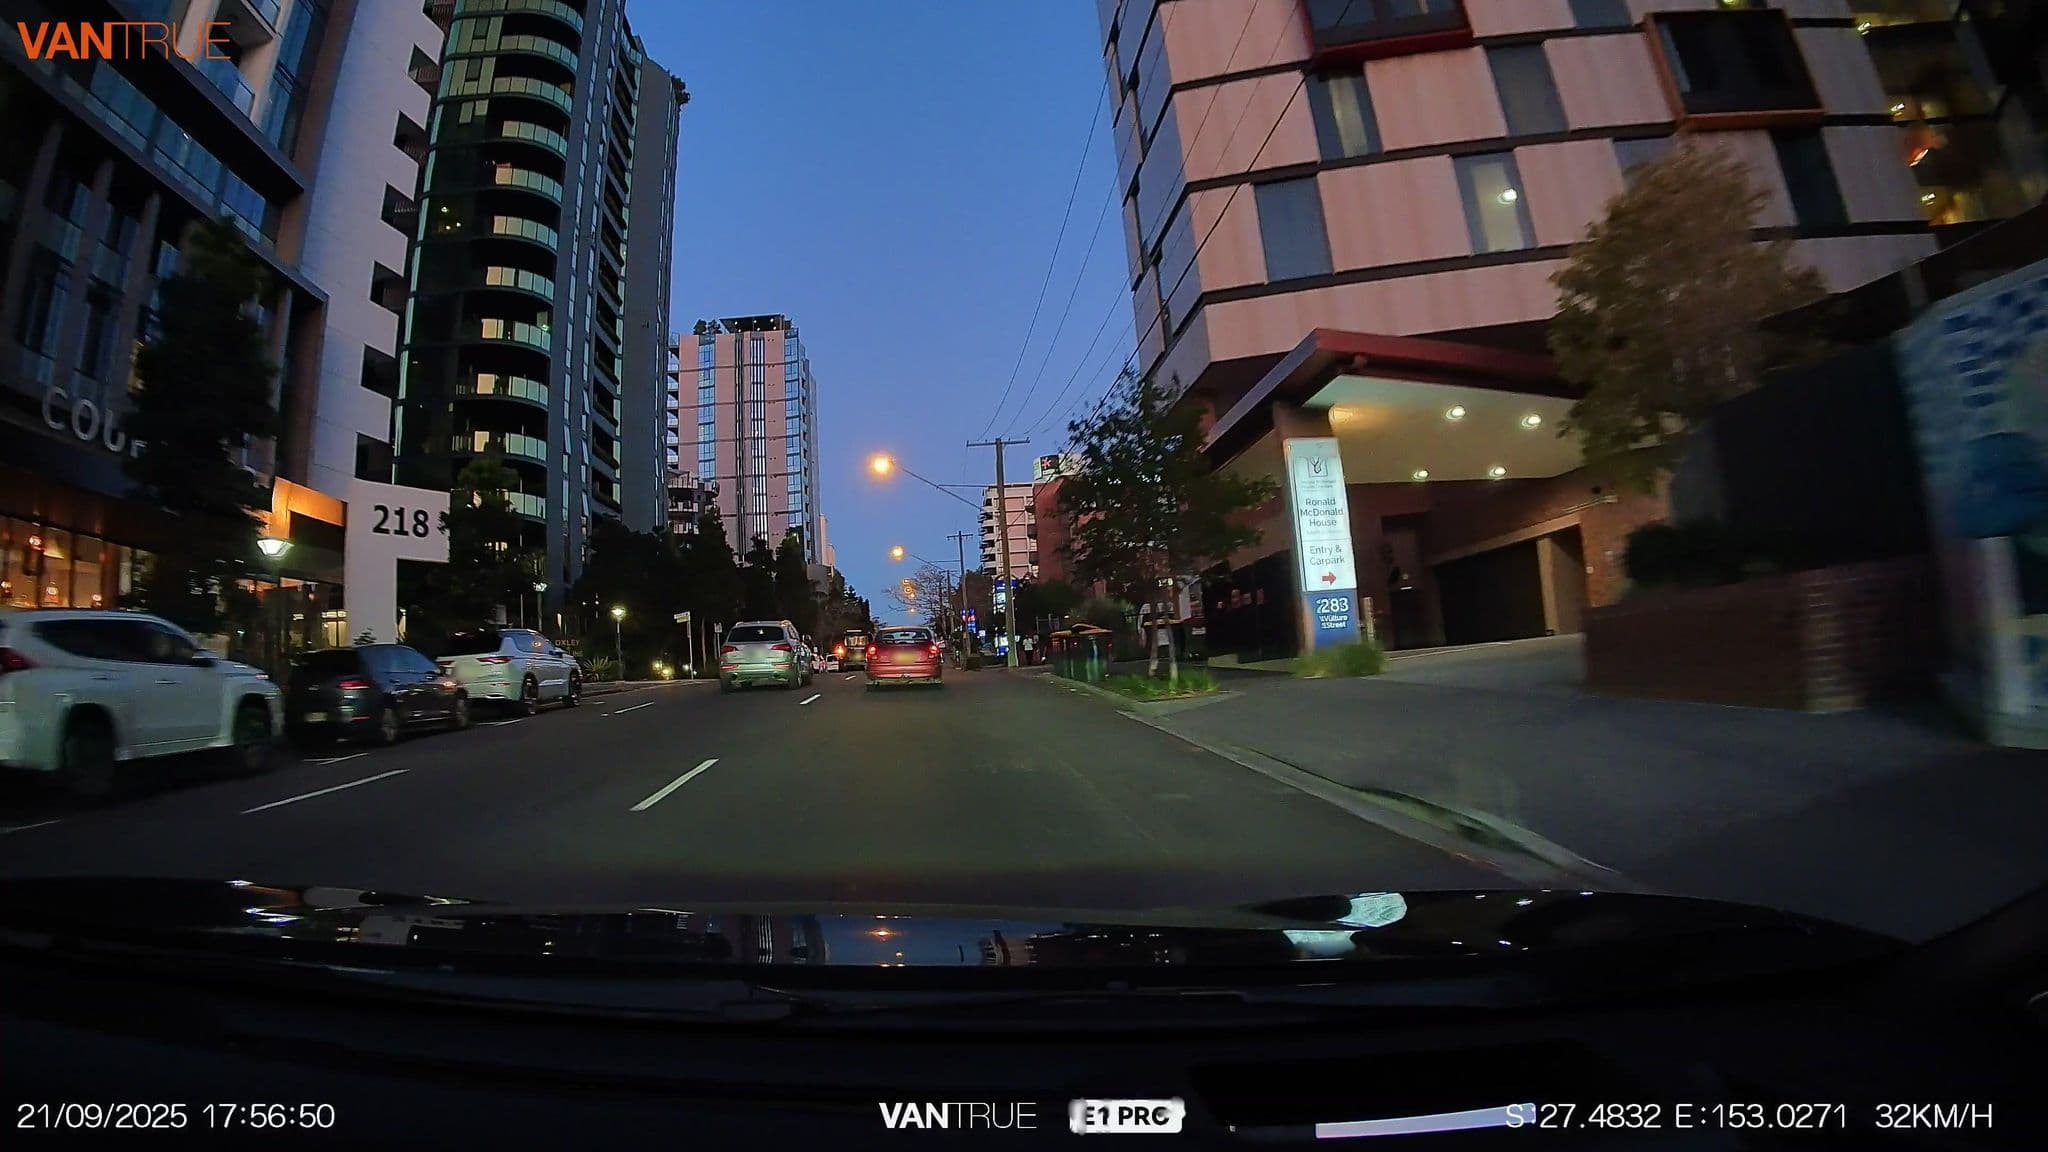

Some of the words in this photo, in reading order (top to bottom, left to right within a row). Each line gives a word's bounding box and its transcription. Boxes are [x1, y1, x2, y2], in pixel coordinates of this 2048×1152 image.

[1305, 498, 1336, 506] Ronald
[1300, 507, 1344, 517] McDonald
[372, 504, 429, 538] 218
[1309, 519, 1337, 527] House
[1309, 545, 1333, 555] Entry
[1335, 544, 1342, 553] &
[1309, 557, 1345, 566] Carpark
[1318, 597, 1349, 614] 283
